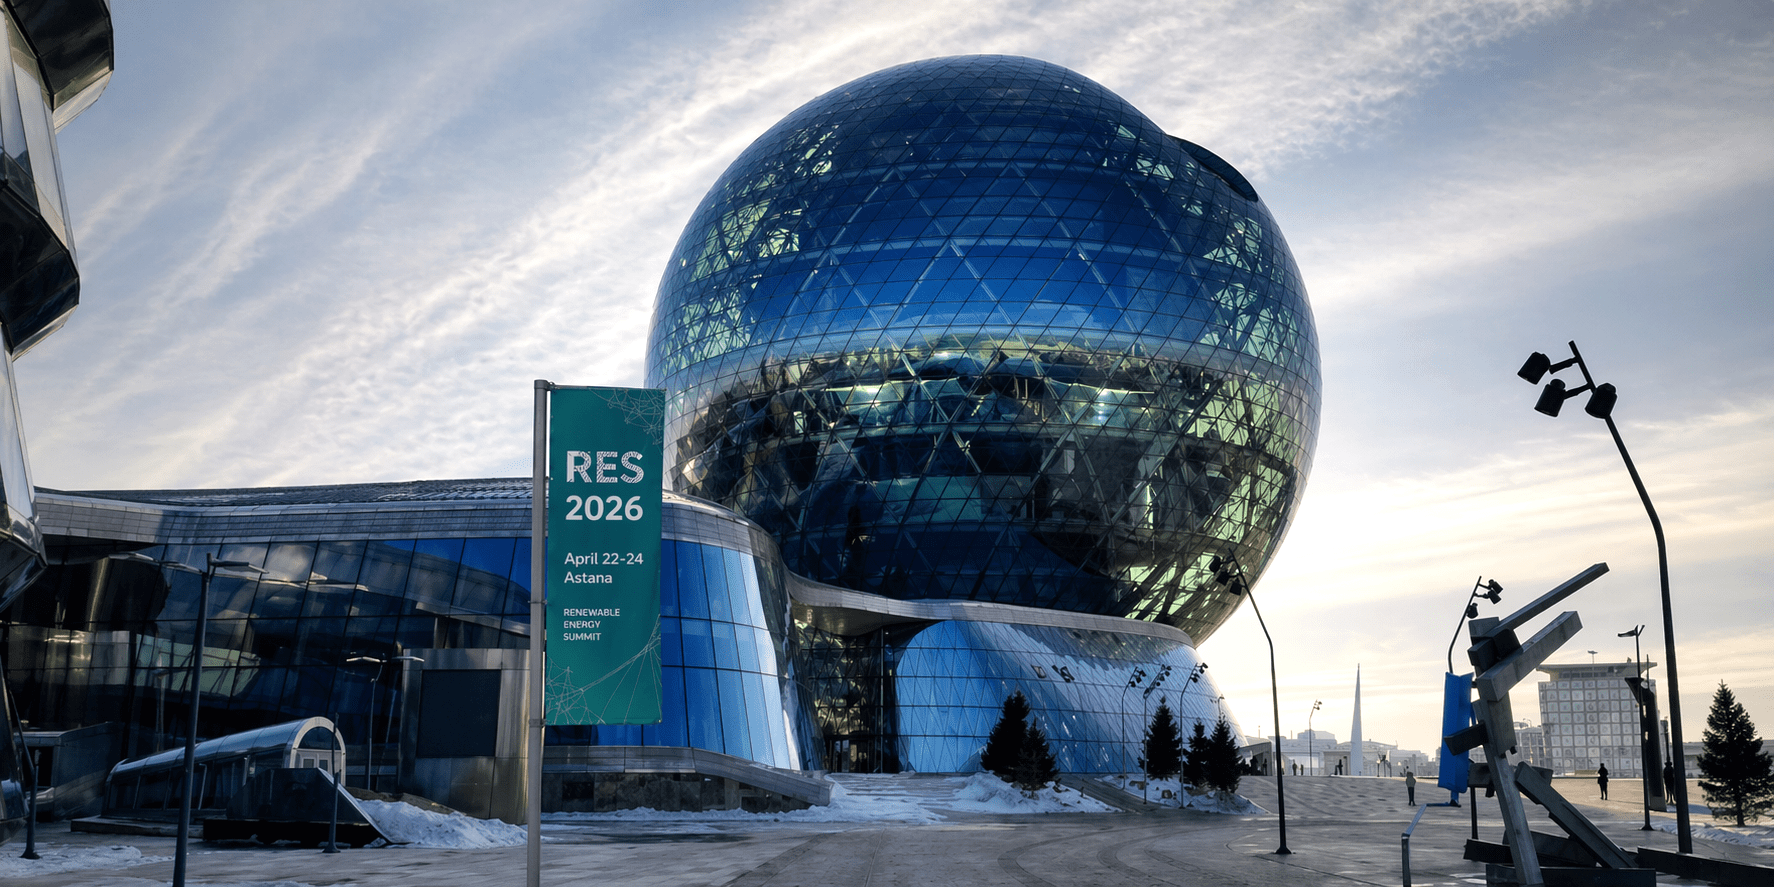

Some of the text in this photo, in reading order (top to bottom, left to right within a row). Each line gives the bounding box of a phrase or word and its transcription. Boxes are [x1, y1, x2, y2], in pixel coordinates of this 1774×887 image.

[566, 450, 645, 484] RES
[565, 495, 644, 521] 2026
[564, 552, 644, 568] April 22-24
[564, 571, 613, 584] Astana
[563, 608, 621, 617] RENEWABLE
[563, 620, 601, 629] ENERGY
[563, 632, 602, 641] SUMMIT
